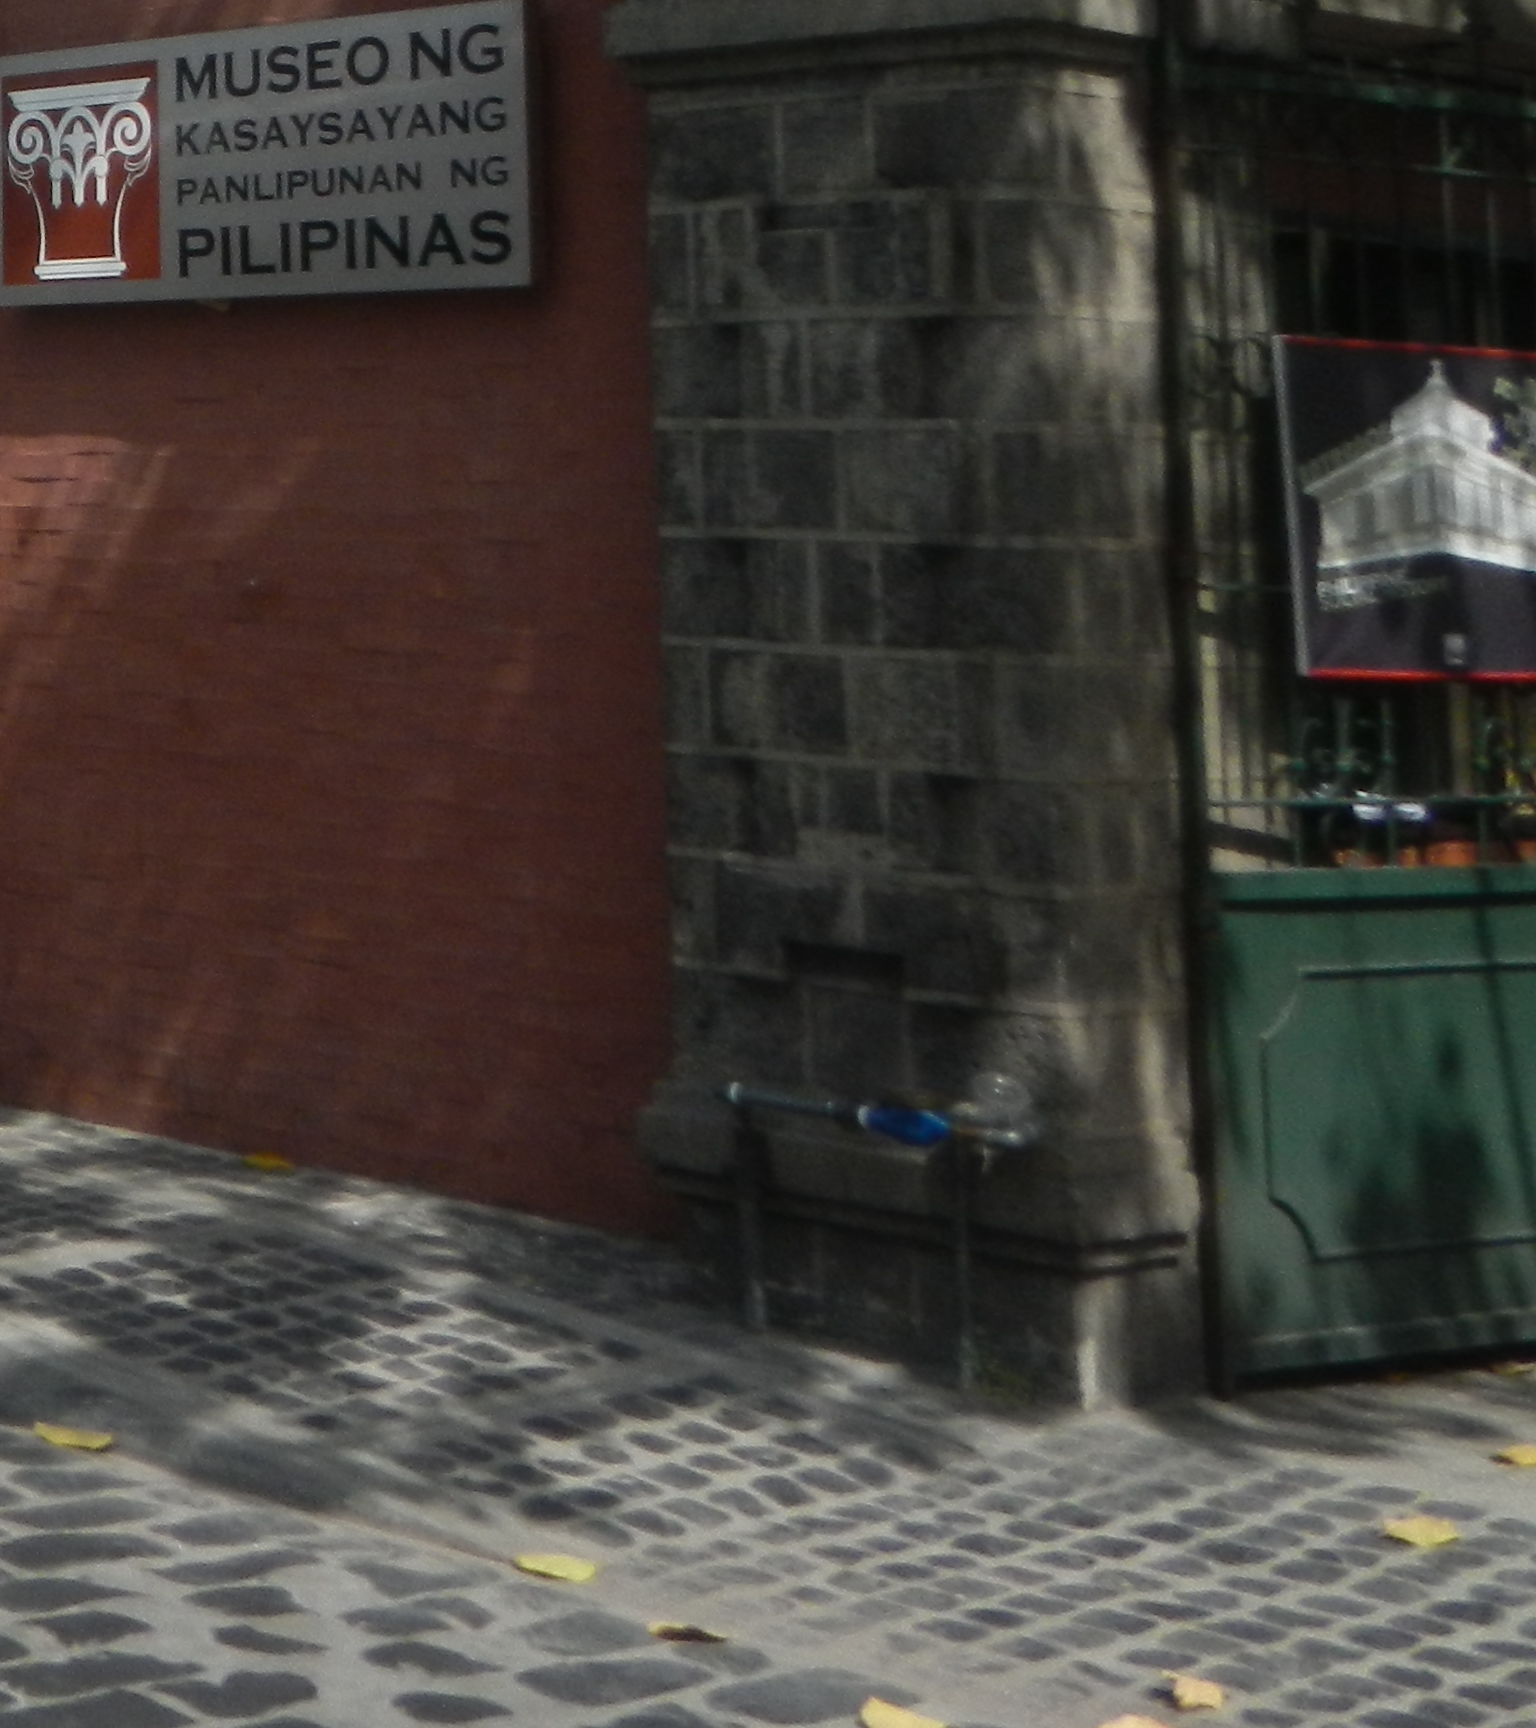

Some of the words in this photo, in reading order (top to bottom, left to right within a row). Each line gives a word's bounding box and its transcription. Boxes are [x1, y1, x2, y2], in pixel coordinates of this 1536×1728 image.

[175, 36, 389, 101] MUSEO
[408, 23, 505, 80] NG
[176, 97, 506, 156] KASAYSAYANG
[177, 162, 422, 206] PANLIPUNAN
[450, 156, 509, 190] NG
[178, 210, 513, 277] PILIPINAS
